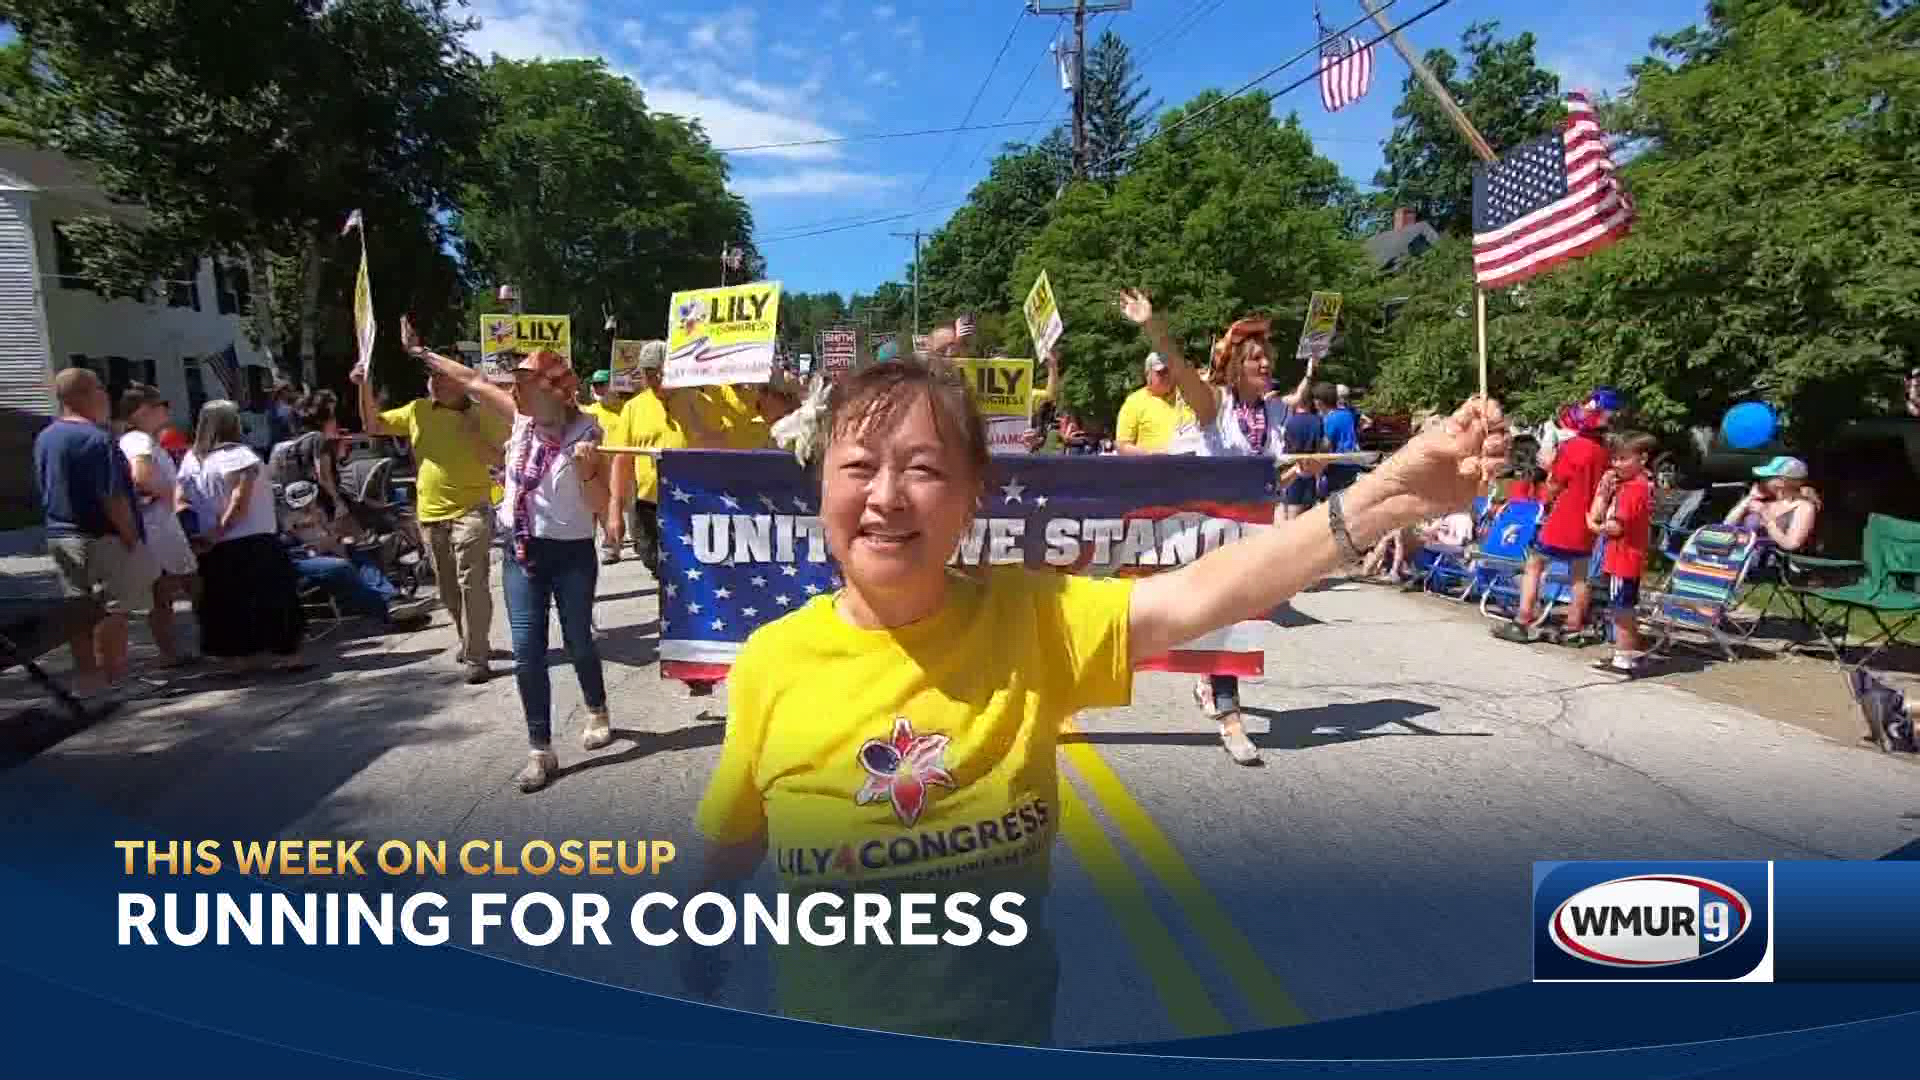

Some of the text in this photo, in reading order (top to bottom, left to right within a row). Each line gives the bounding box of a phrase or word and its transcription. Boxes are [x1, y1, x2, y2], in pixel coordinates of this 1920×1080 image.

[710, 291, 771, 323] LILY
[516, 321, 564, 341] LILY
[691, 512, 829, 564] UNIT
